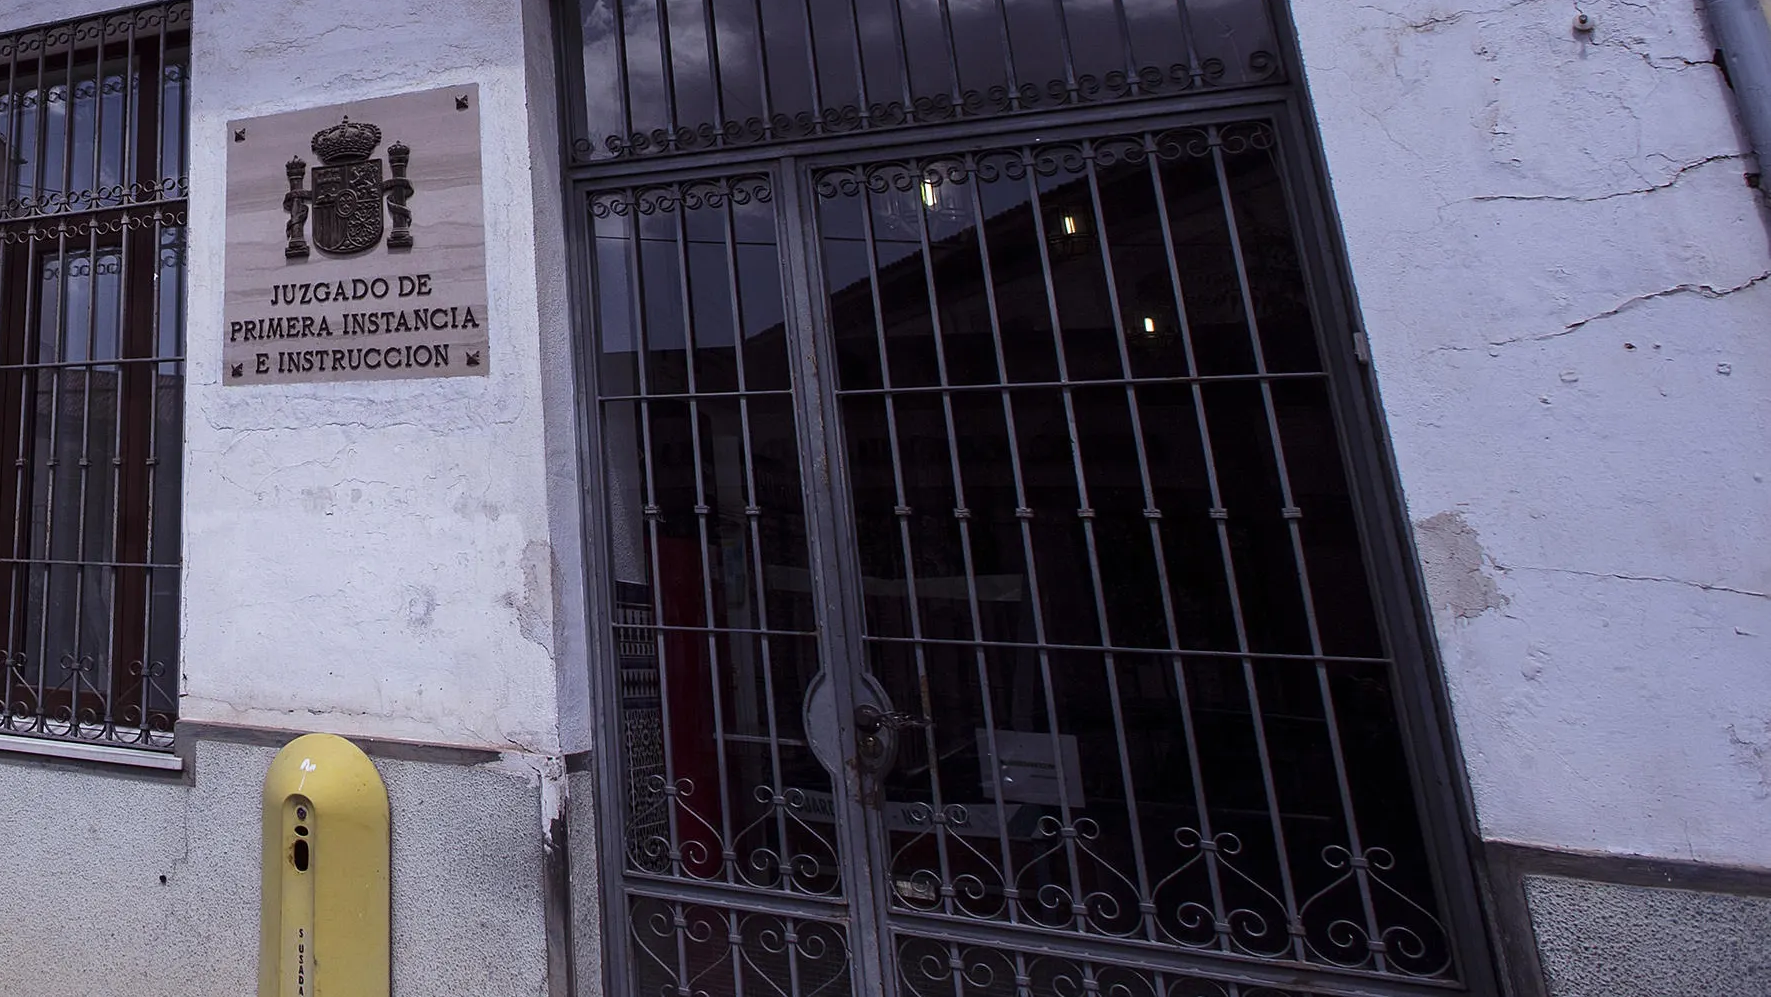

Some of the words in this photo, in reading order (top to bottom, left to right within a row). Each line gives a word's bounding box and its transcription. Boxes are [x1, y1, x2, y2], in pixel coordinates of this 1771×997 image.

[270, 277, 389, 306] JUZGADO
[398, 274, 432, 297] DE
[230, 315, 333, 342] PRIMERA
[342, 306, 480, 335] INSTANCIA
[255, 353, 269, 374] E
[278, 344, 449, 373] INSTRUCCION
